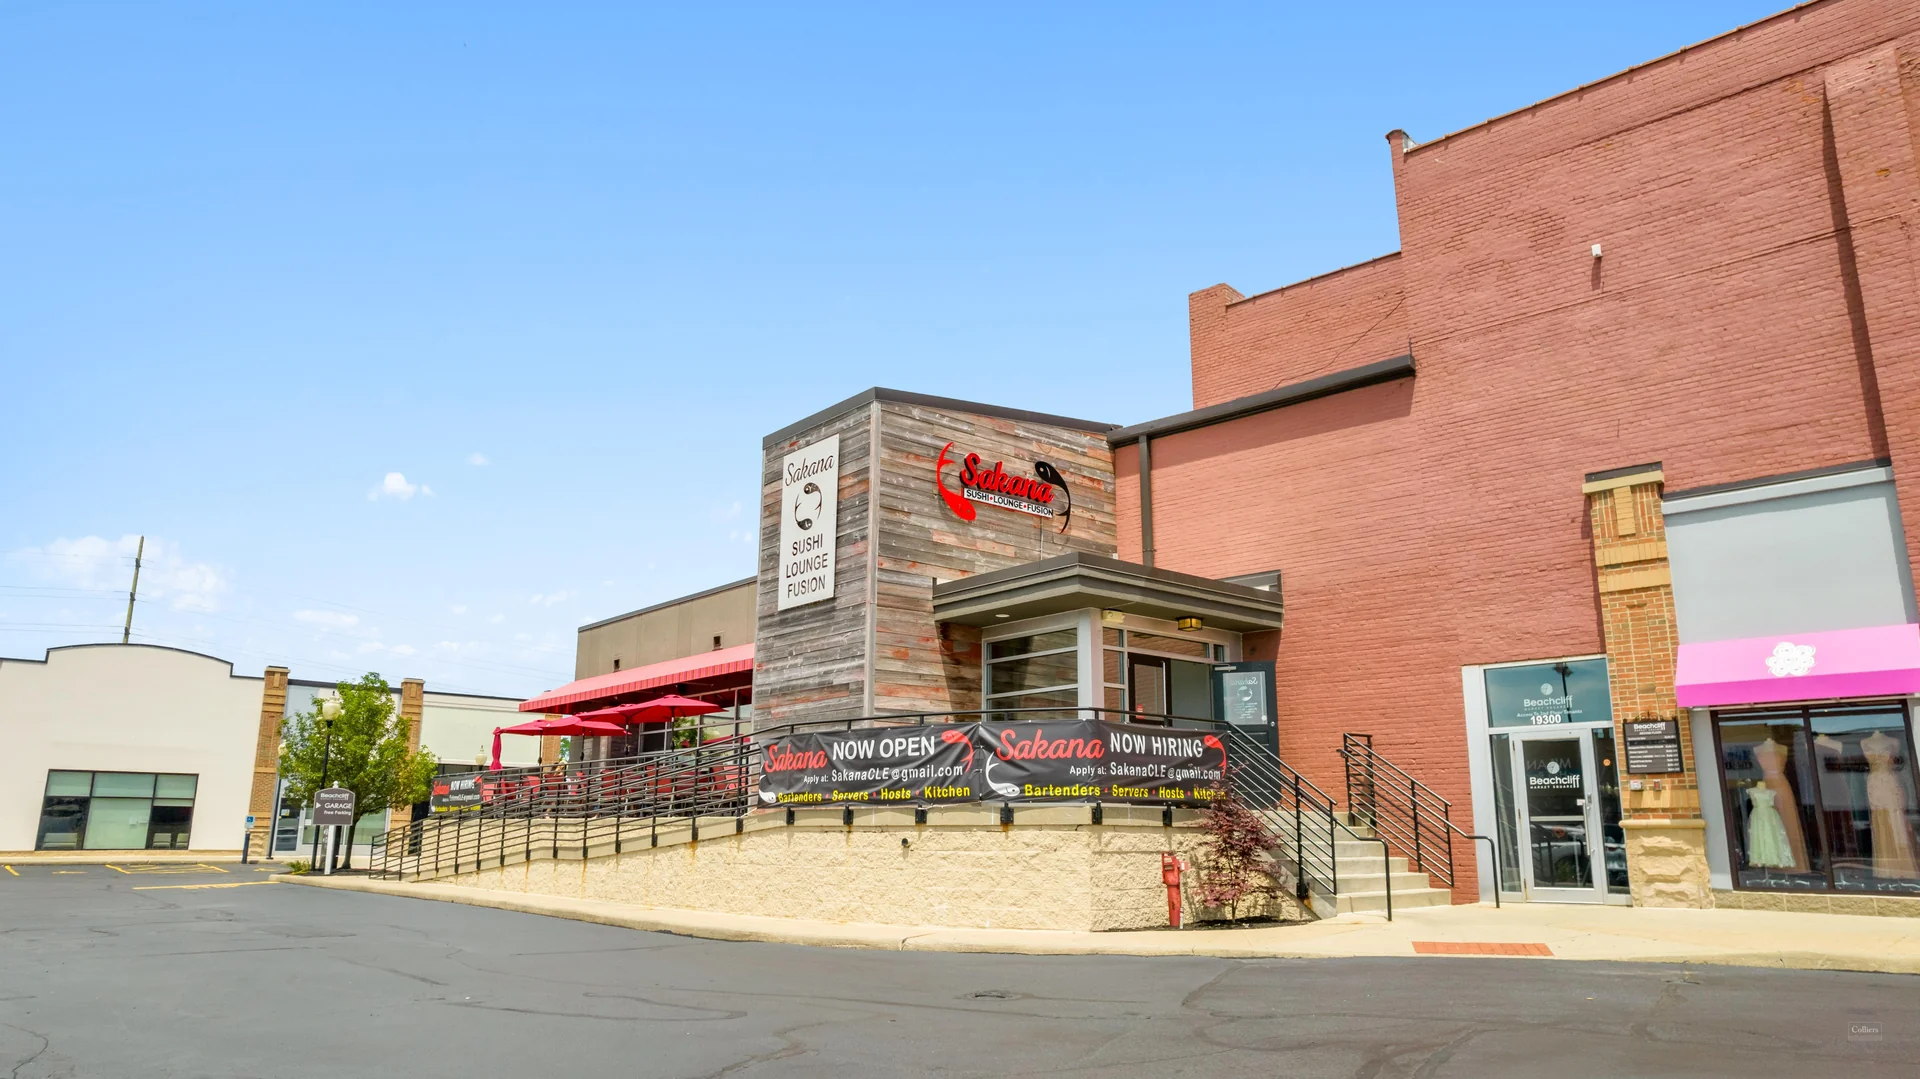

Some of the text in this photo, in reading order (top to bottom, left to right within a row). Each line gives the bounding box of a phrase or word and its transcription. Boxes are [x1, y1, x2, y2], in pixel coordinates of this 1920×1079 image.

[785, 455, 834, 486] Sakana
[960, 452, 1055, 503] Sakana
[966, 489, 1053, 516] SUSHI LOUNGE FUSION
[792, 533, 823, 556] SUSHI
[786, 553, 828, 578] LOUNGE
[788, 575, 826, 598] FUSION
[1523, 695, 1573, 708] Beachcliff
[1530, 714, 1562, 725] 19300
[764, 735, 935, 773] Sakana NOW OPEN
[996, 729, 1203, 760] Sakana NOW HIRING
[803, 764, 963, 785] Apply at: SakanaCLE@gmail.com
[1069, 765, 1095, 776] Apply
[1097, 766, 1107, 775] at:
[1529, 775, 1580, 788] Beachcliff
[778, 785, 970, 803] Bartenders Servers Hosts Kitchen
[1024, 784, 1100, 797] Bartenders
[1112, 785, 1149, 798] Servers
[1159, 787, 1185, 799] Hosts
